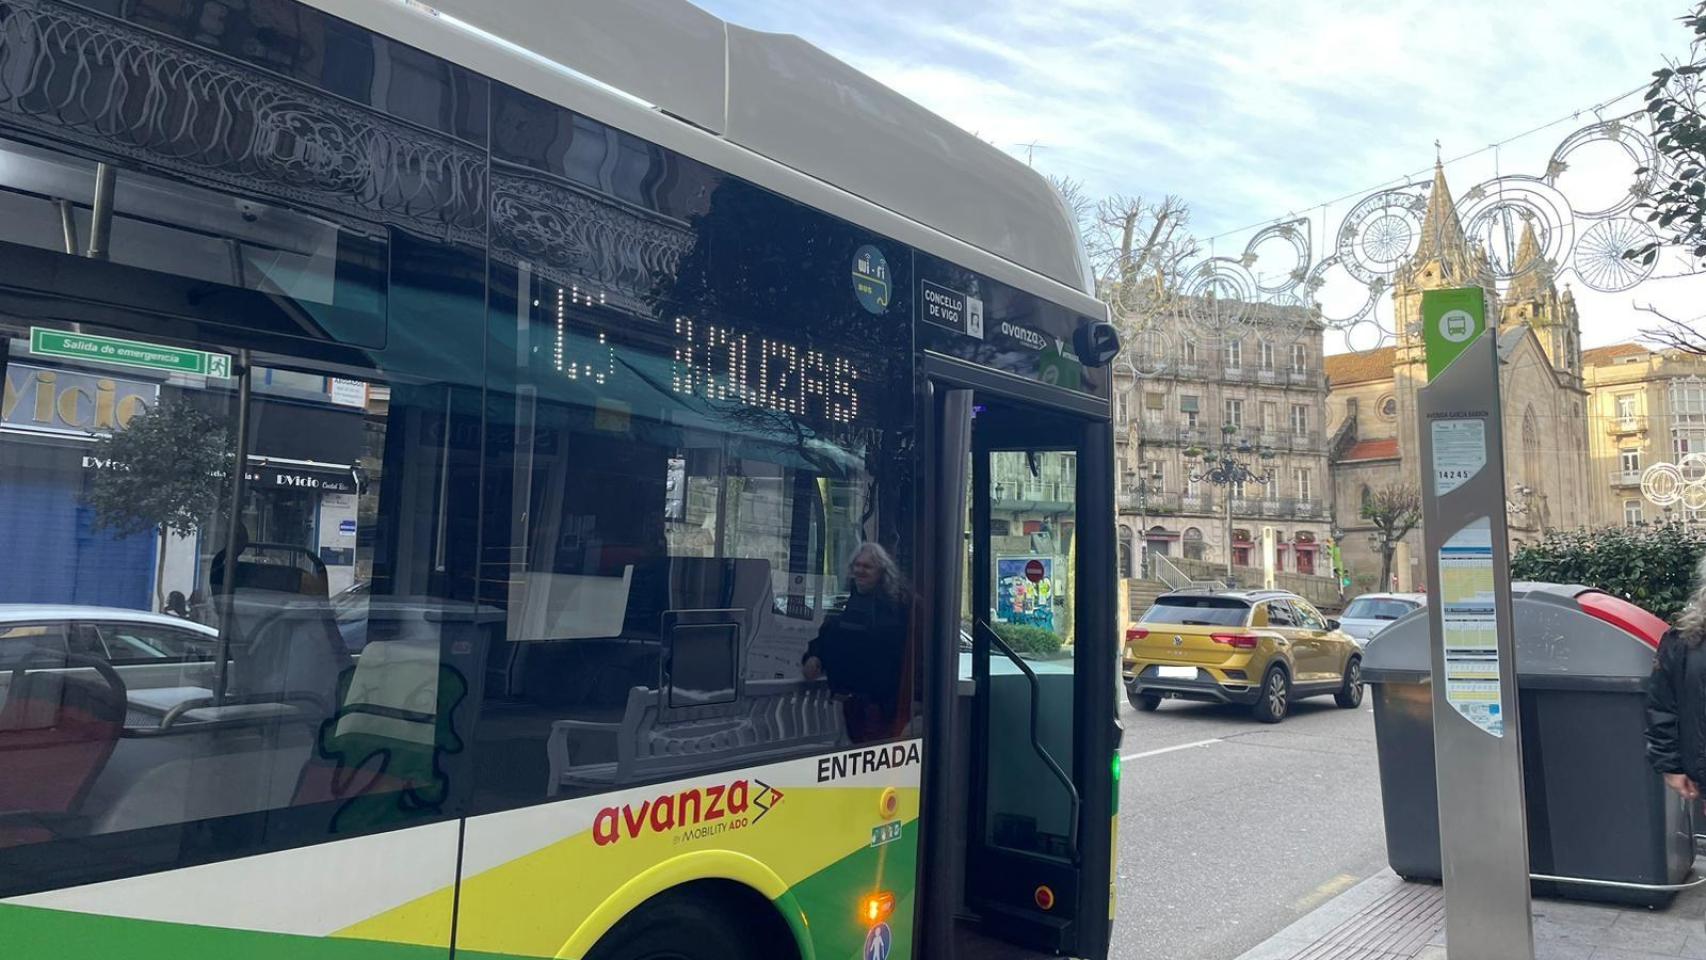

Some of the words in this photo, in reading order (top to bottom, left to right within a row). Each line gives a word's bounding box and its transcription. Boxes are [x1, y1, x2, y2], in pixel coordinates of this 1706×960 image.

[925, 289, 963, 312] CONCELLO
[929, 304, 940, 317] DE
[941, 307, 959, 323] VIGO
[1001, 321, 1039, 345] avanza
[63, 338, 98, 352] Salida
[101, 342, 115, 355] de
[117, 347, 180, 363] emergencia
[276, 474, 320, 488] DVicio
[1439, 471, 1468, 479] 14245
[817, 743, 920, 783] ENTRADA
[592, 779, 749, 846] avanza
[682, 822, 727, 842] MOBILITY
[729, 817, 748, 830] ADO
